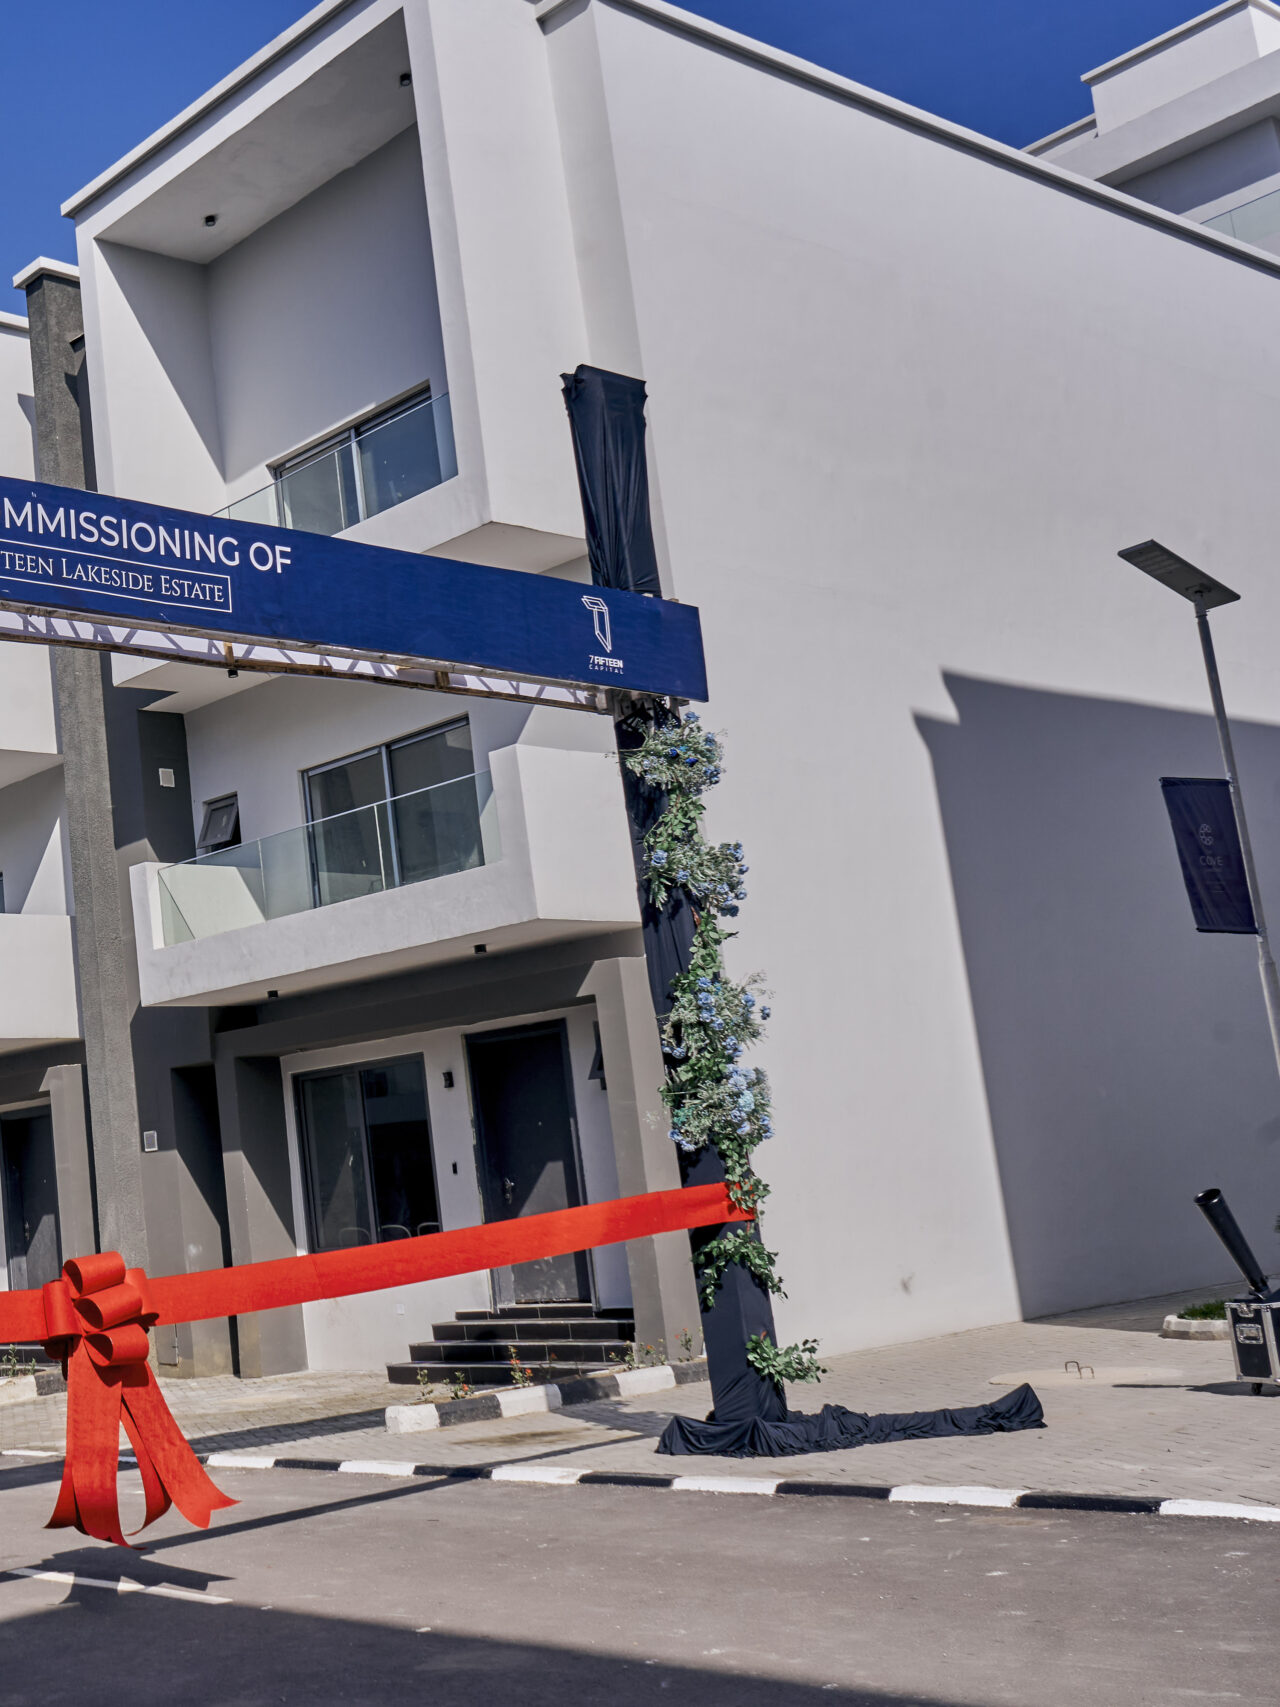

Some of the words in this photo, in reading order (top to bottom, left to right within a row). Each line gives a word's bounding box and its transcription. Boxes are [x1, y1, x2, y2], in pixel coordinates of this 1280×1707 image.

[249, 541, 291, 574] OF
[62, 558, 154, 592] LAKESIDE
[160, 575, 225, 603] ESTATE
[588, 664, 624, 675] CAPITAL
[594, 656, 624, 668] FIFTEEN
